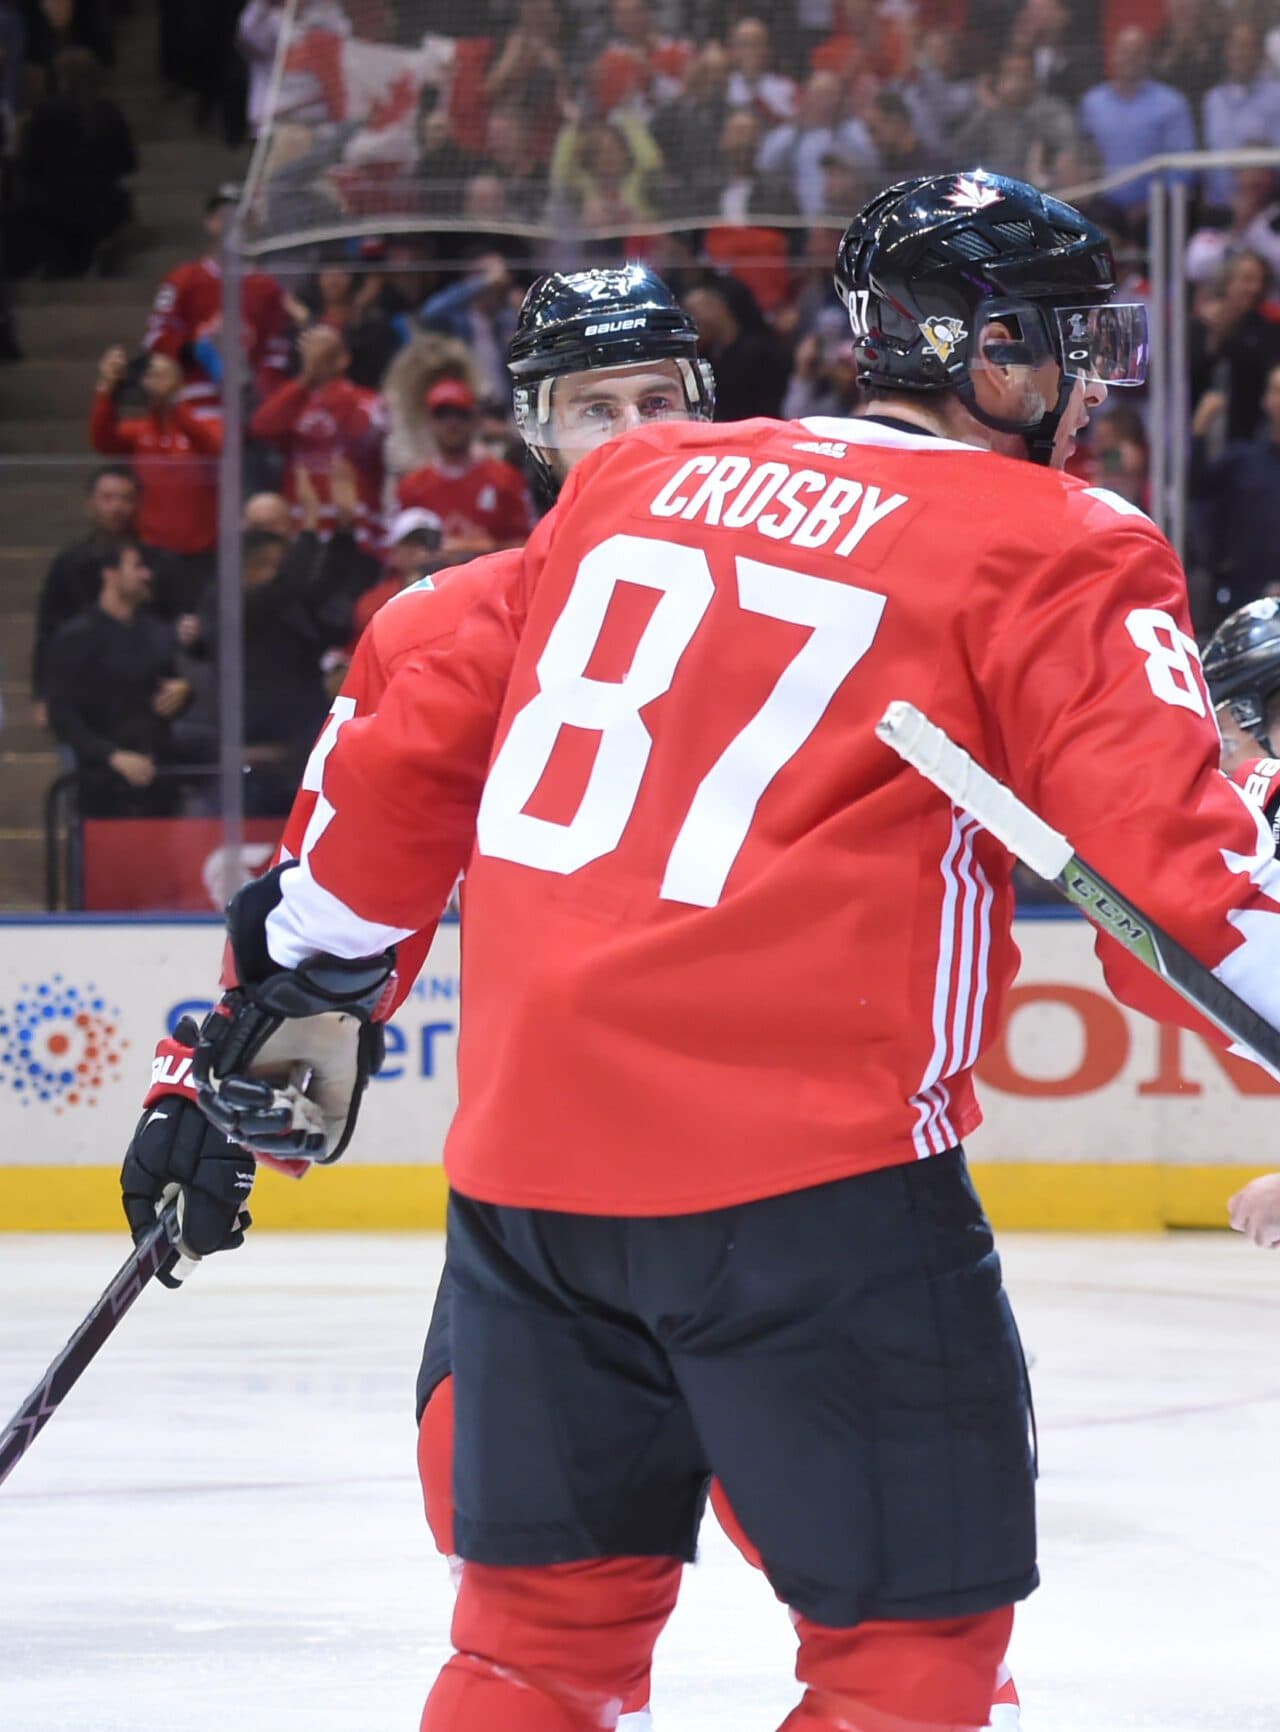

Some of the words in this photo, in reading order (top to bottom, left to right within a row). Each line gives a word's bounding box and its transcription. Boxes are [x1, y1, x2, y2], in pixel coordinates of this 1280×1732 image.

[585, 318, 647, 337] BAUER
[848, 290, 869, 337] 87
[650, 456, 908, 556] CROSBY
[477, 533, 888, 908] 87
[1071, 877, 1143, 940] CCM
